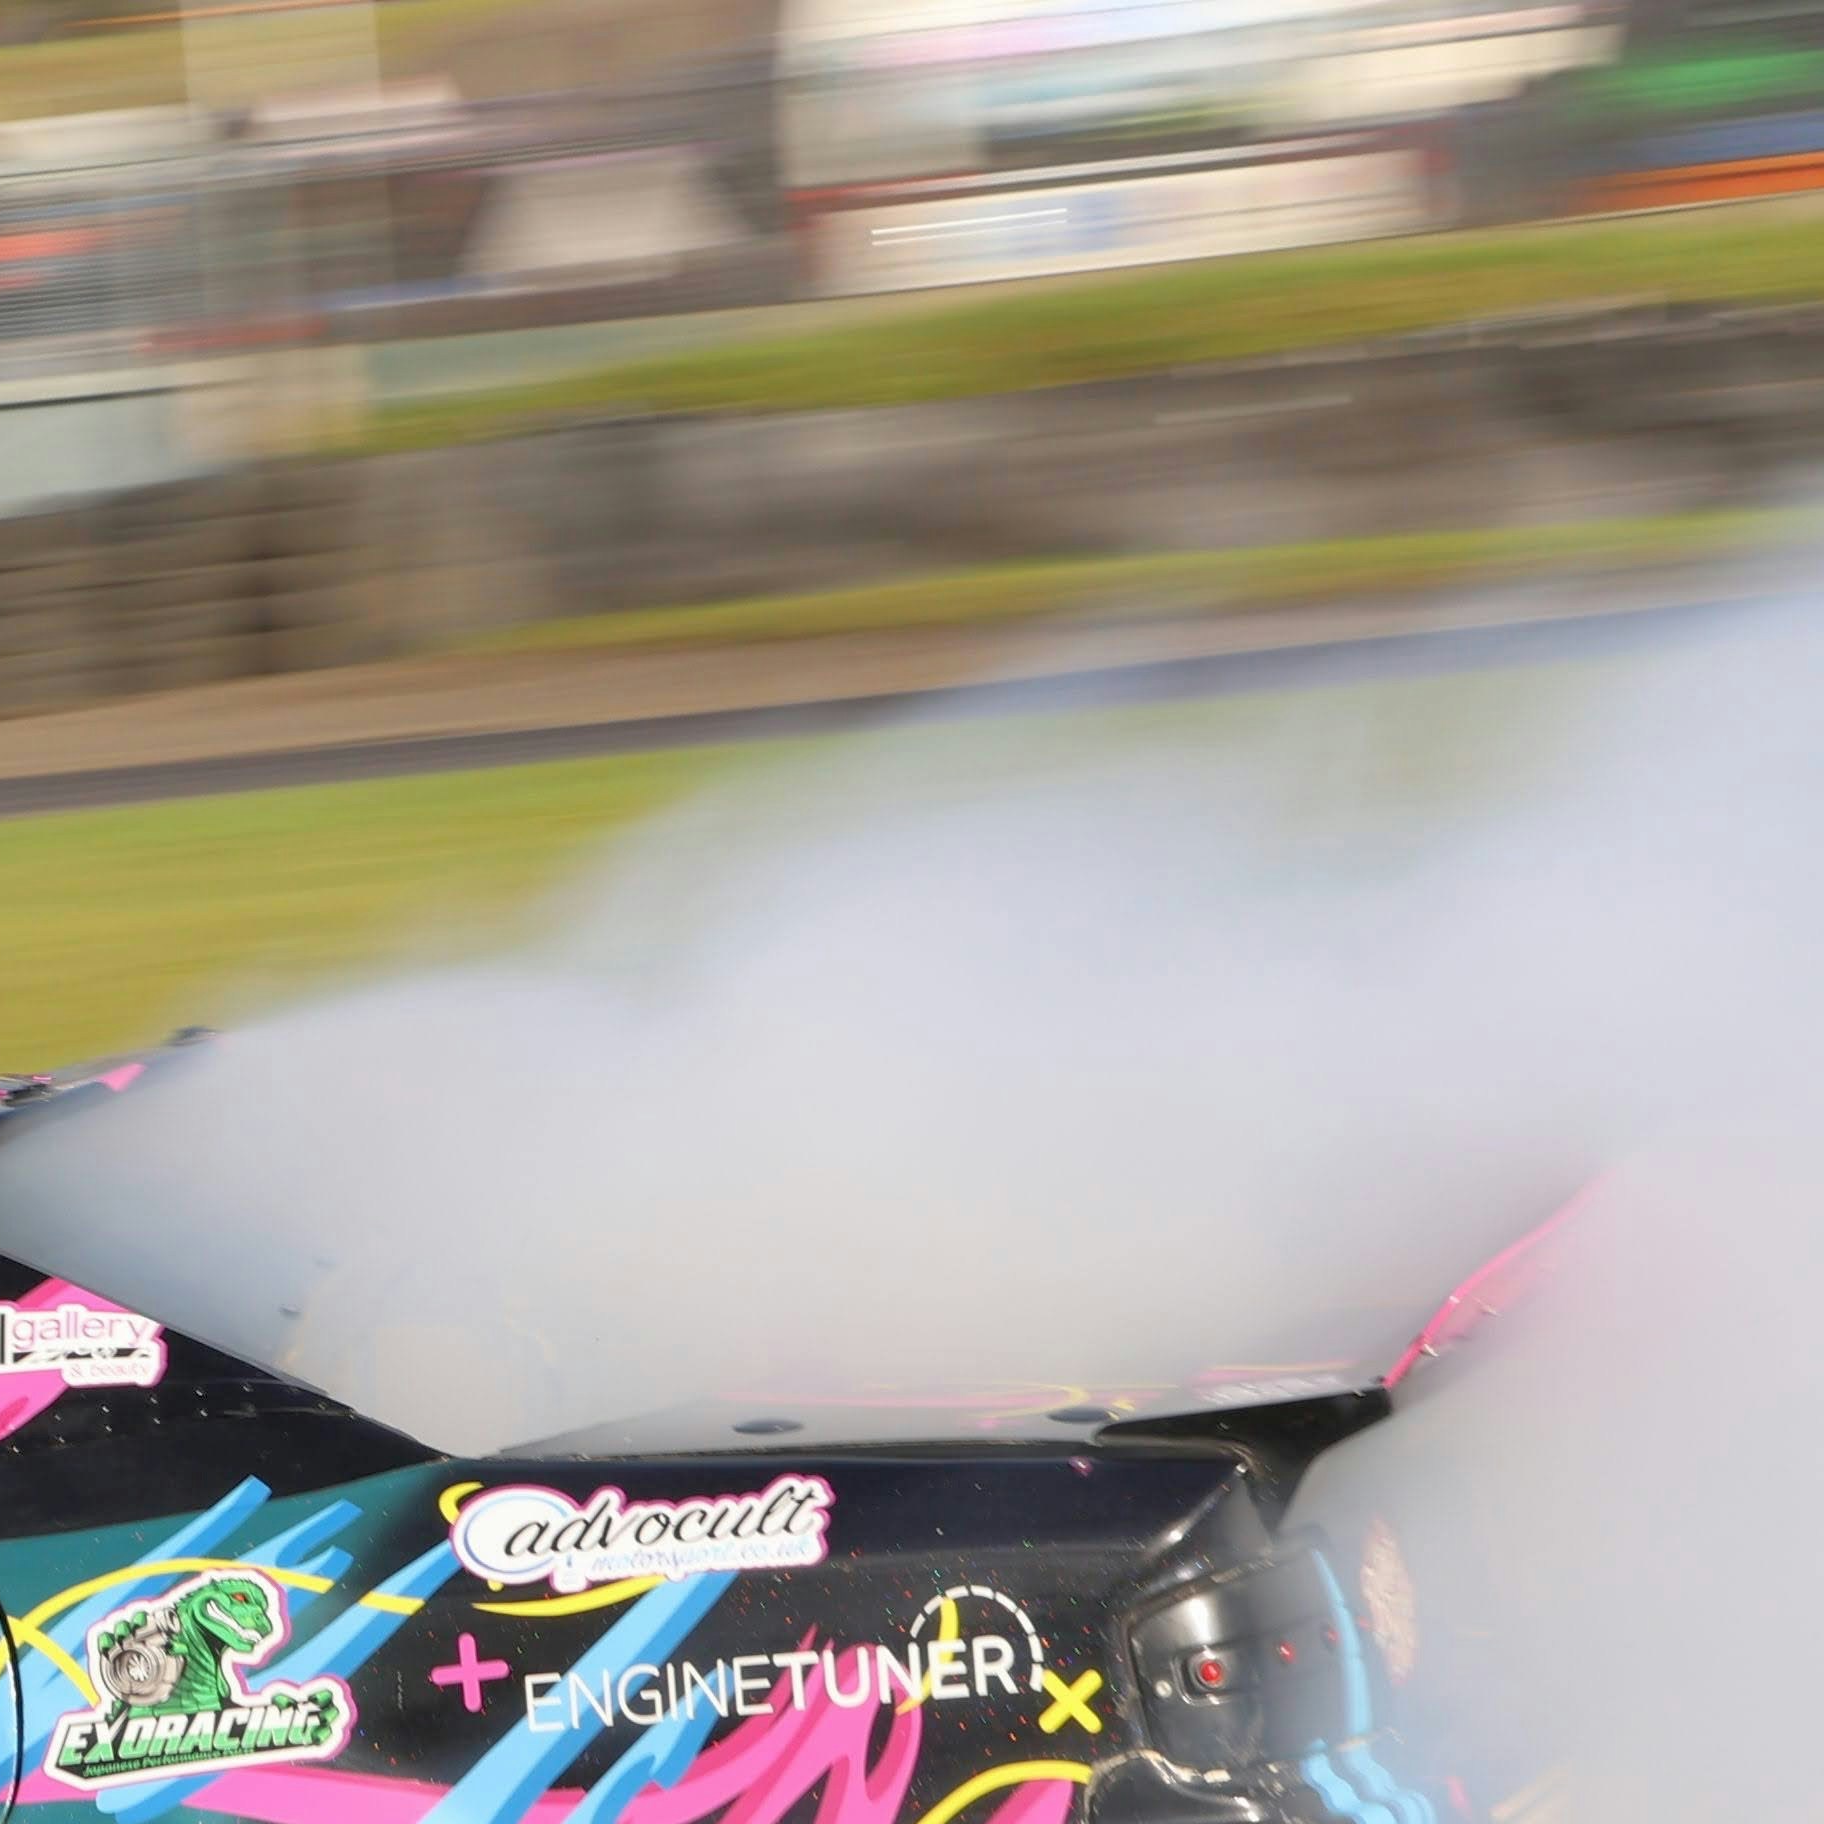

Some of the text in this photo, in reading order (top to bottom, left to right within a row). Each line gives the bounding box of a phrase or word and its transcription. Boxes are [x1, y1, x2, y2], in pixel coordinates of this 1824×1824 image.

[13, 1311, 150, 1348] gallery
[505, 1485, 818, 1558] advocult
[522, 1635, 1020, 1732] ENGINETUNER
[58, 1703, 323, 1767] EXORACING
